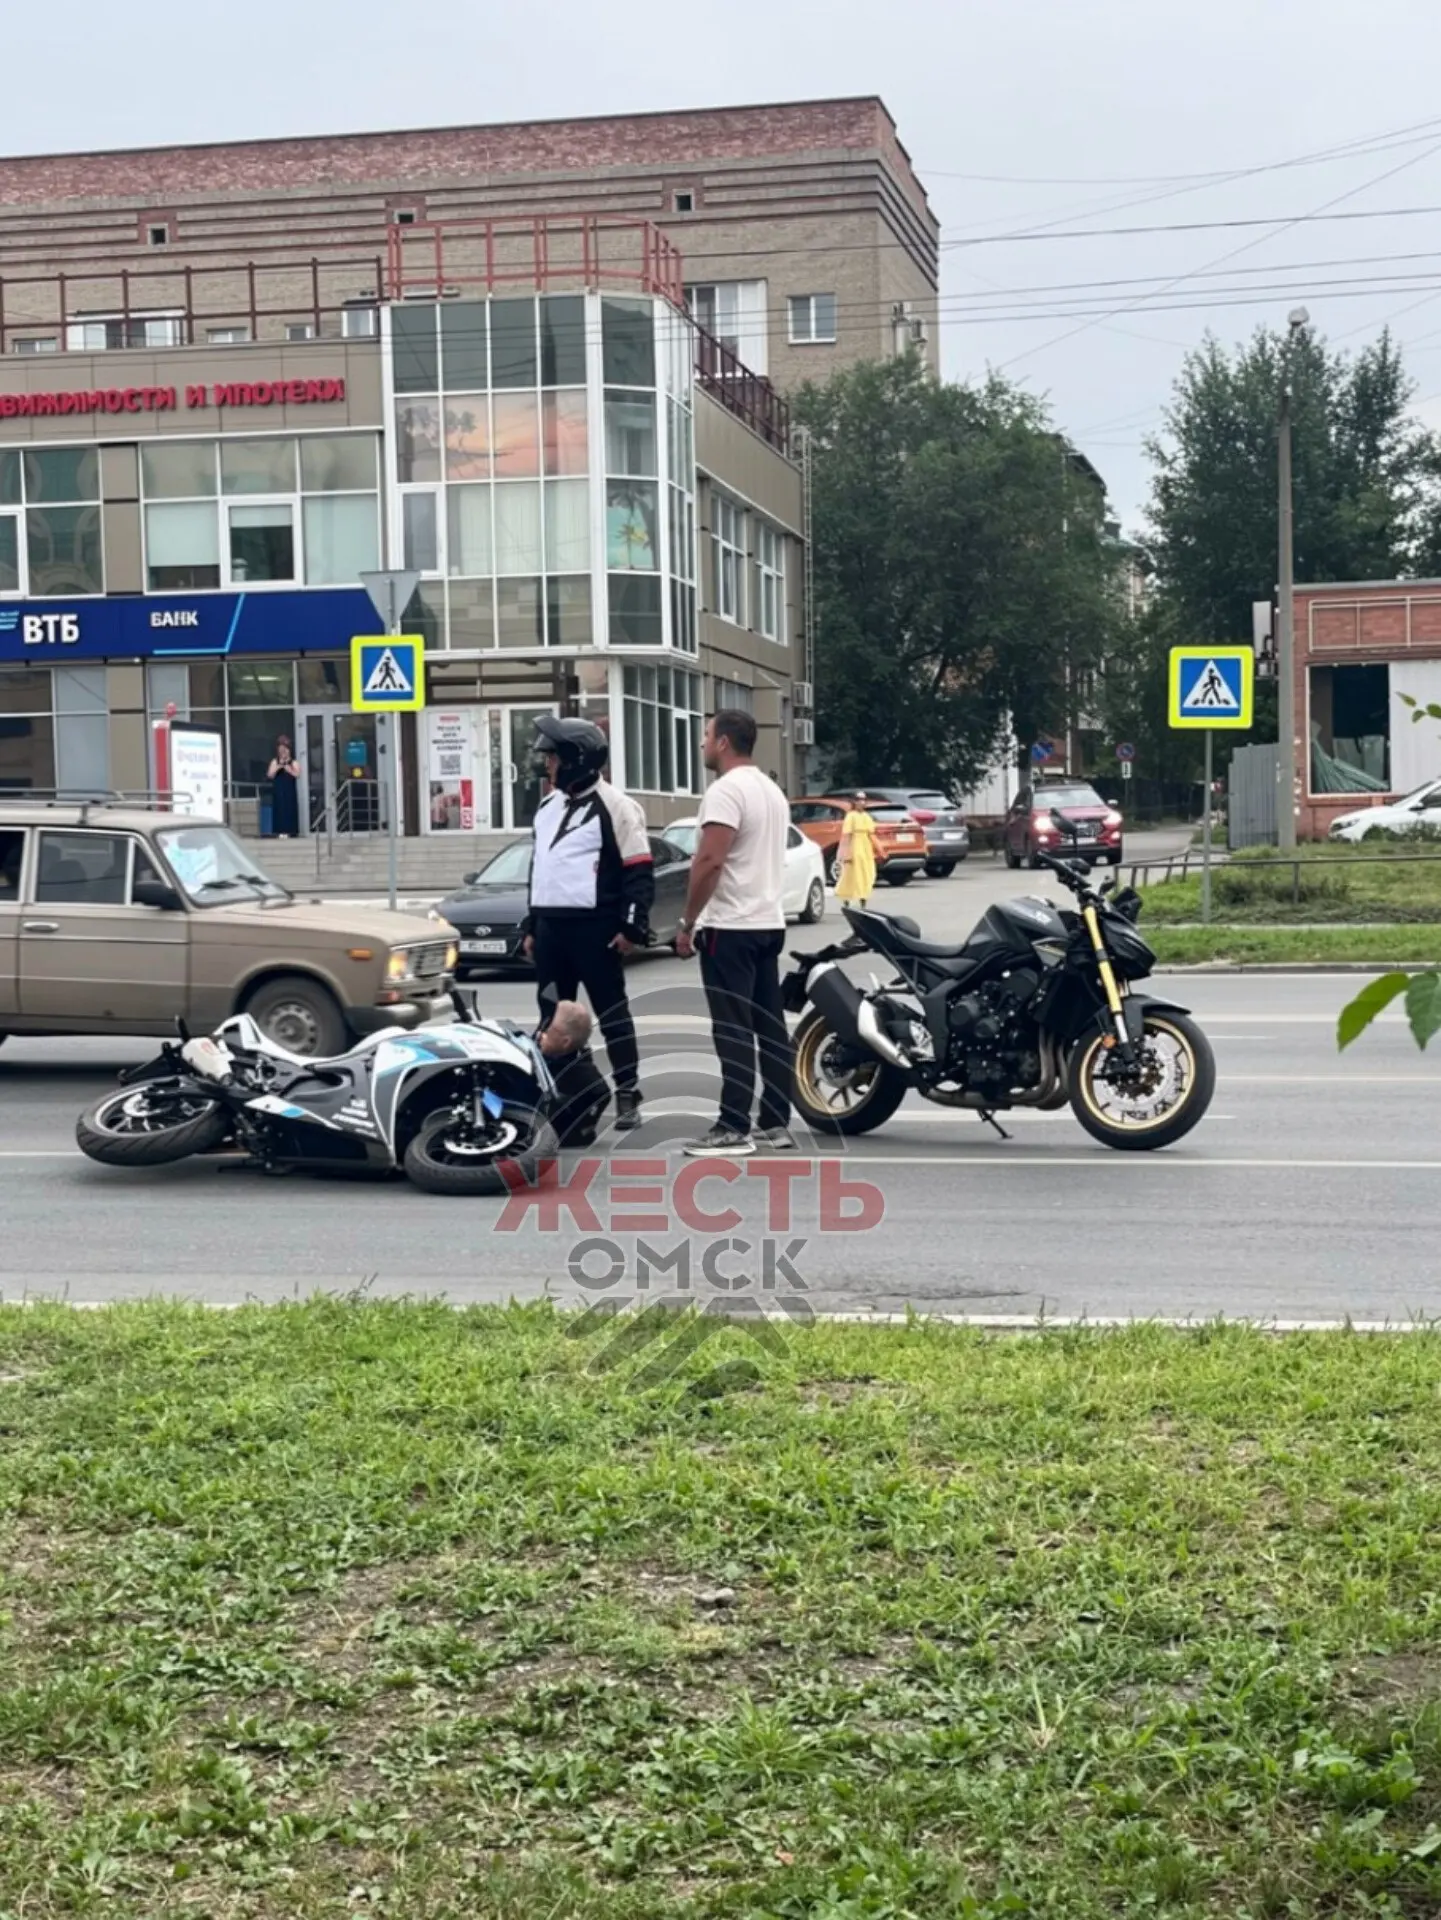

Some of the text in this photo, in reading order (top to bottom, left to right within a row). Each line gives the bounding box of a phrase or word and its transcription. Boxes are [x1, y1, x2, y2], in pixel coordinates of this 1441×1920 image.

[0, 378, 345, 418] ВИЖИМОСТИ И ИПОТЕКИ
[23, 611, 199, 643] ВТБ БАНК
